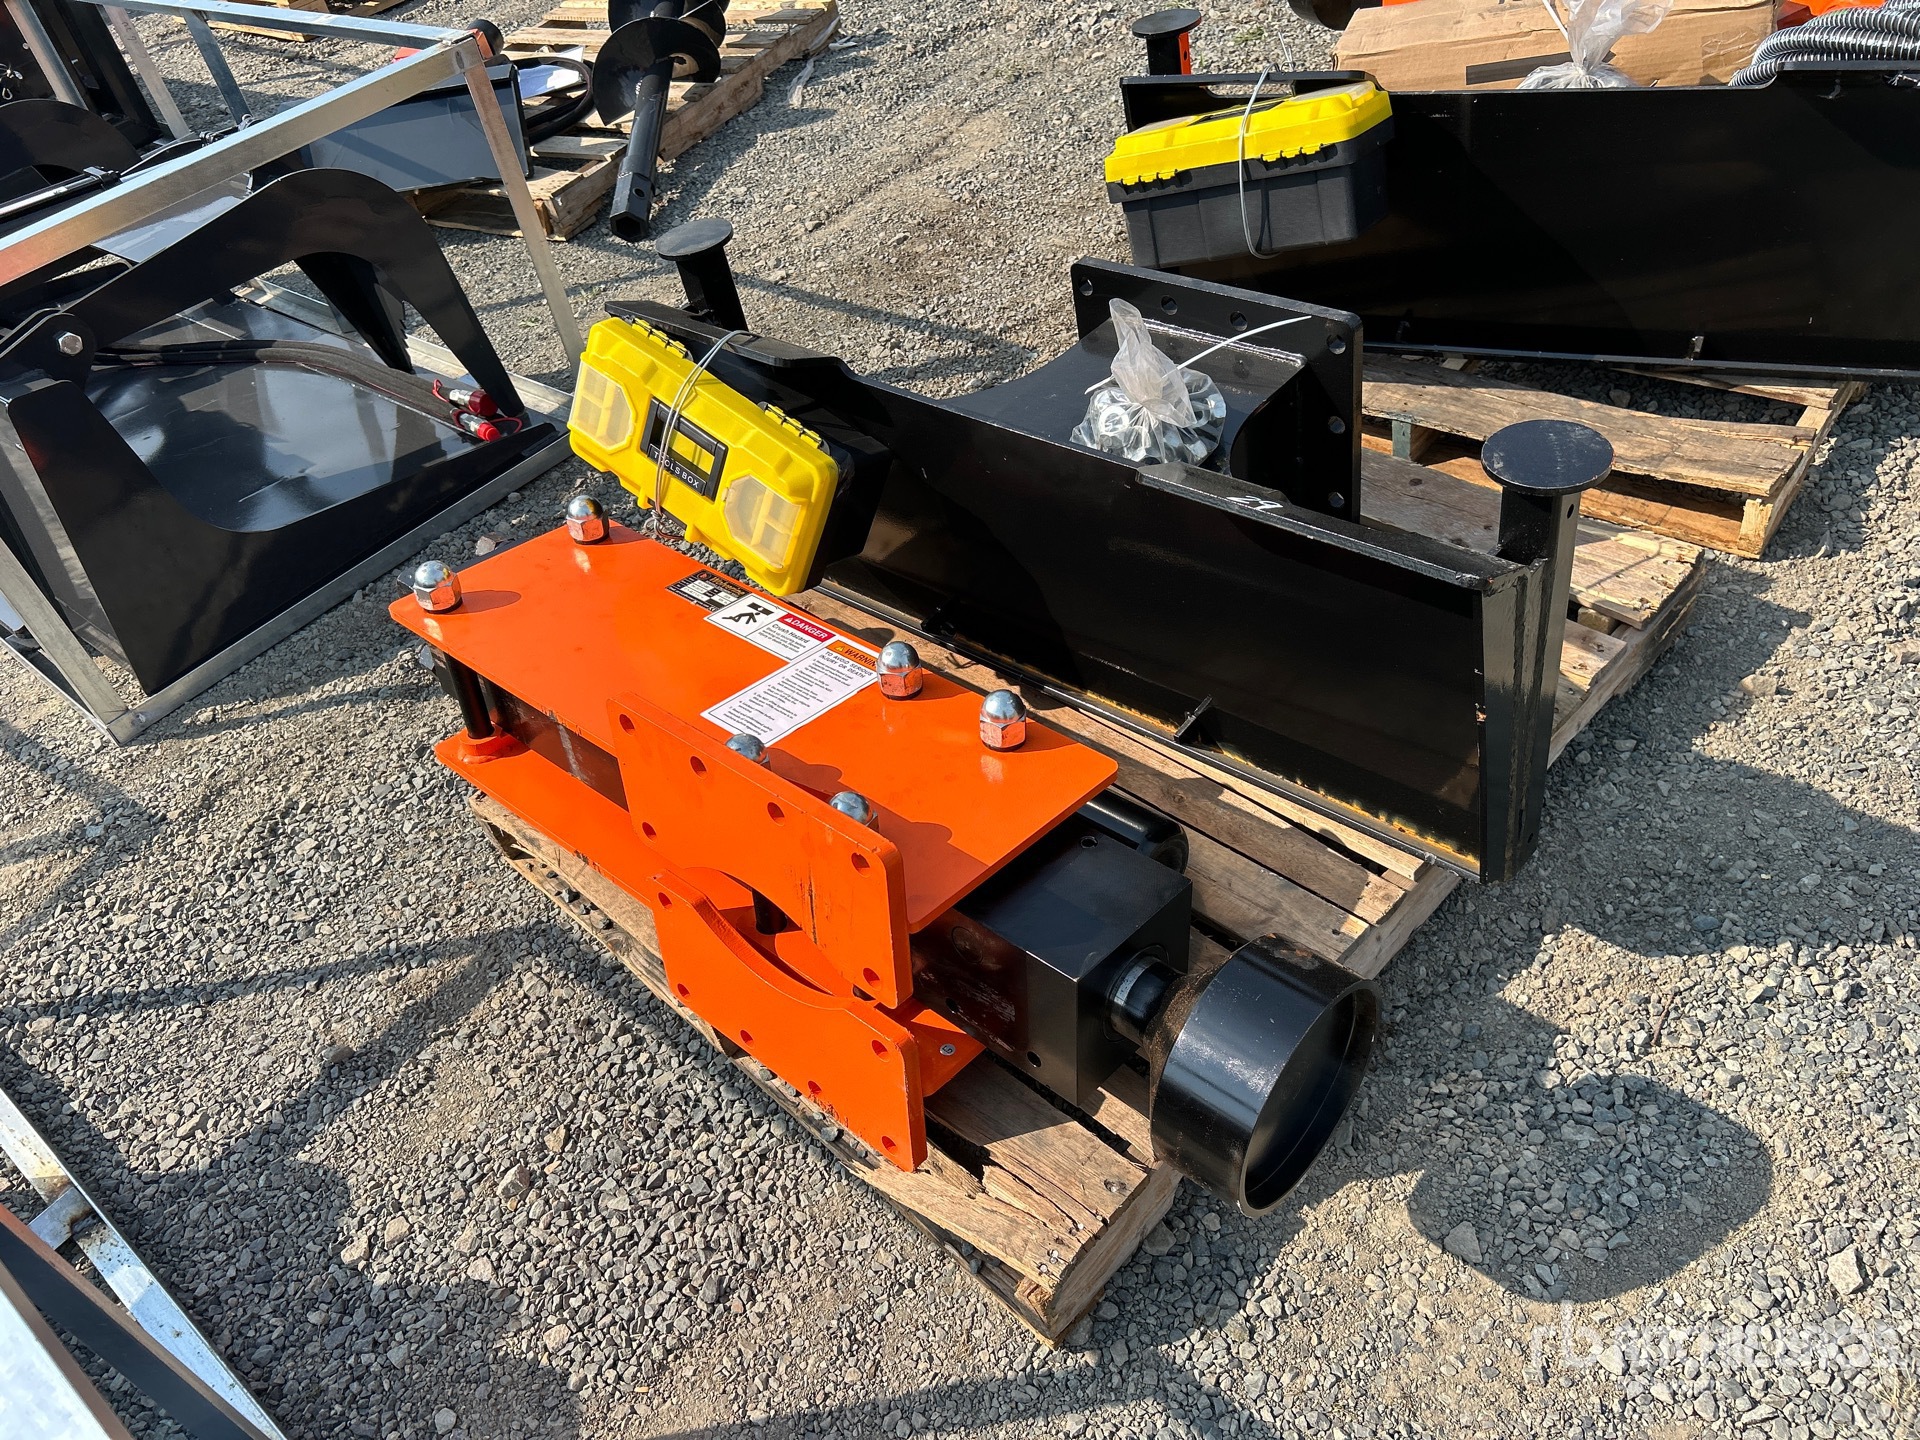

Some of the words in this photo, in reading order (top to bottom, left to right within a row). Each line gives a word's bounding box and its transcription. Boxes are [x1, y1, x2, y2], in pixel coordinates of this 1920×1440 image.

[682, 471, 699, 488] BOX
[771, 623, 789, 634] Crush
[788, 631, 810, 643] Hazard
[791, 619, 828, 639] DANGER
[819, 654, 839, 664] INJURY
[847, 667, 866, 678] DEATH
[833, 655, 850, 664] AVOID
[850, 663, 873, 676] SERIOUS
[845, 648, 876, 668] WARNIN
